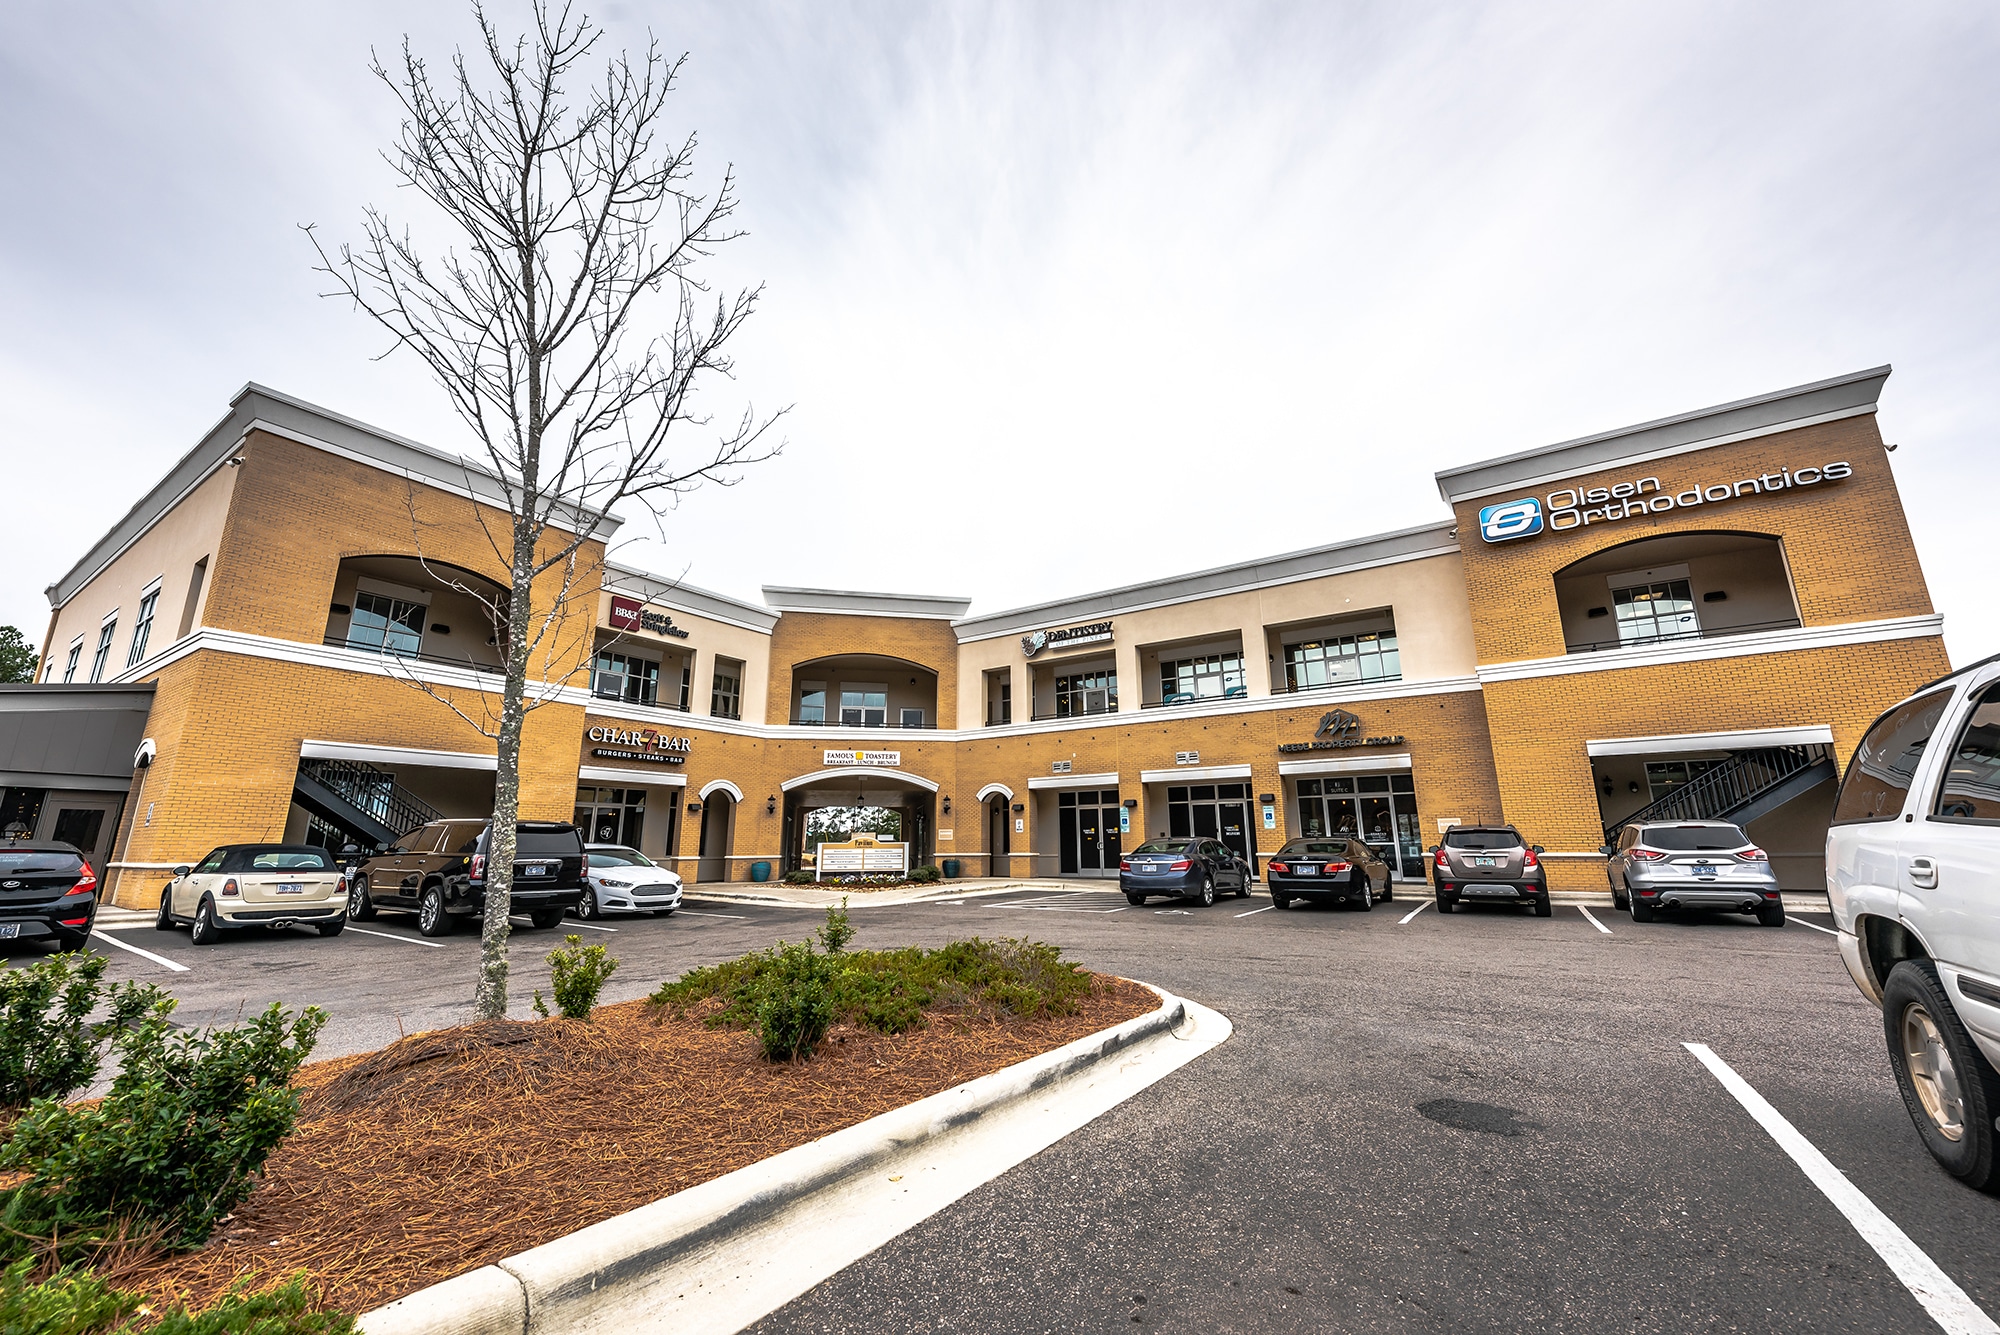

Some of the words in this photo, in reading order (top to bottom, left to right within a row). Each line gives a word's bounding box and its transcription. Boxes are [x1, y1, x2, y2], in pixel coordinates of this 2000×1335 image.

[1546, 475, 1660, 511] Olsen
[1548, 460, 1853, 532] Orthodontics
[641, 609, 665, 623] Scott
[641, 620, 690, 639] Stringfellow
[1048, 621, 1113, 641] DENTISTRY
[587, 726, 643, 747] CHAR
[643, 729, 658, 752] 7
[658, 734, 692, 752] BAR
[1278, 742, 1309, 753] MEESE
[1312, 738, 1364, 750] PROPERTY
[1366, 735, 1405, 746] GROUP
[597, 749, 632, 759] BURGERS
[638, 753, 664, 762] STEAKS
[1891, 1052, 1934, 1141] MICHELIN
